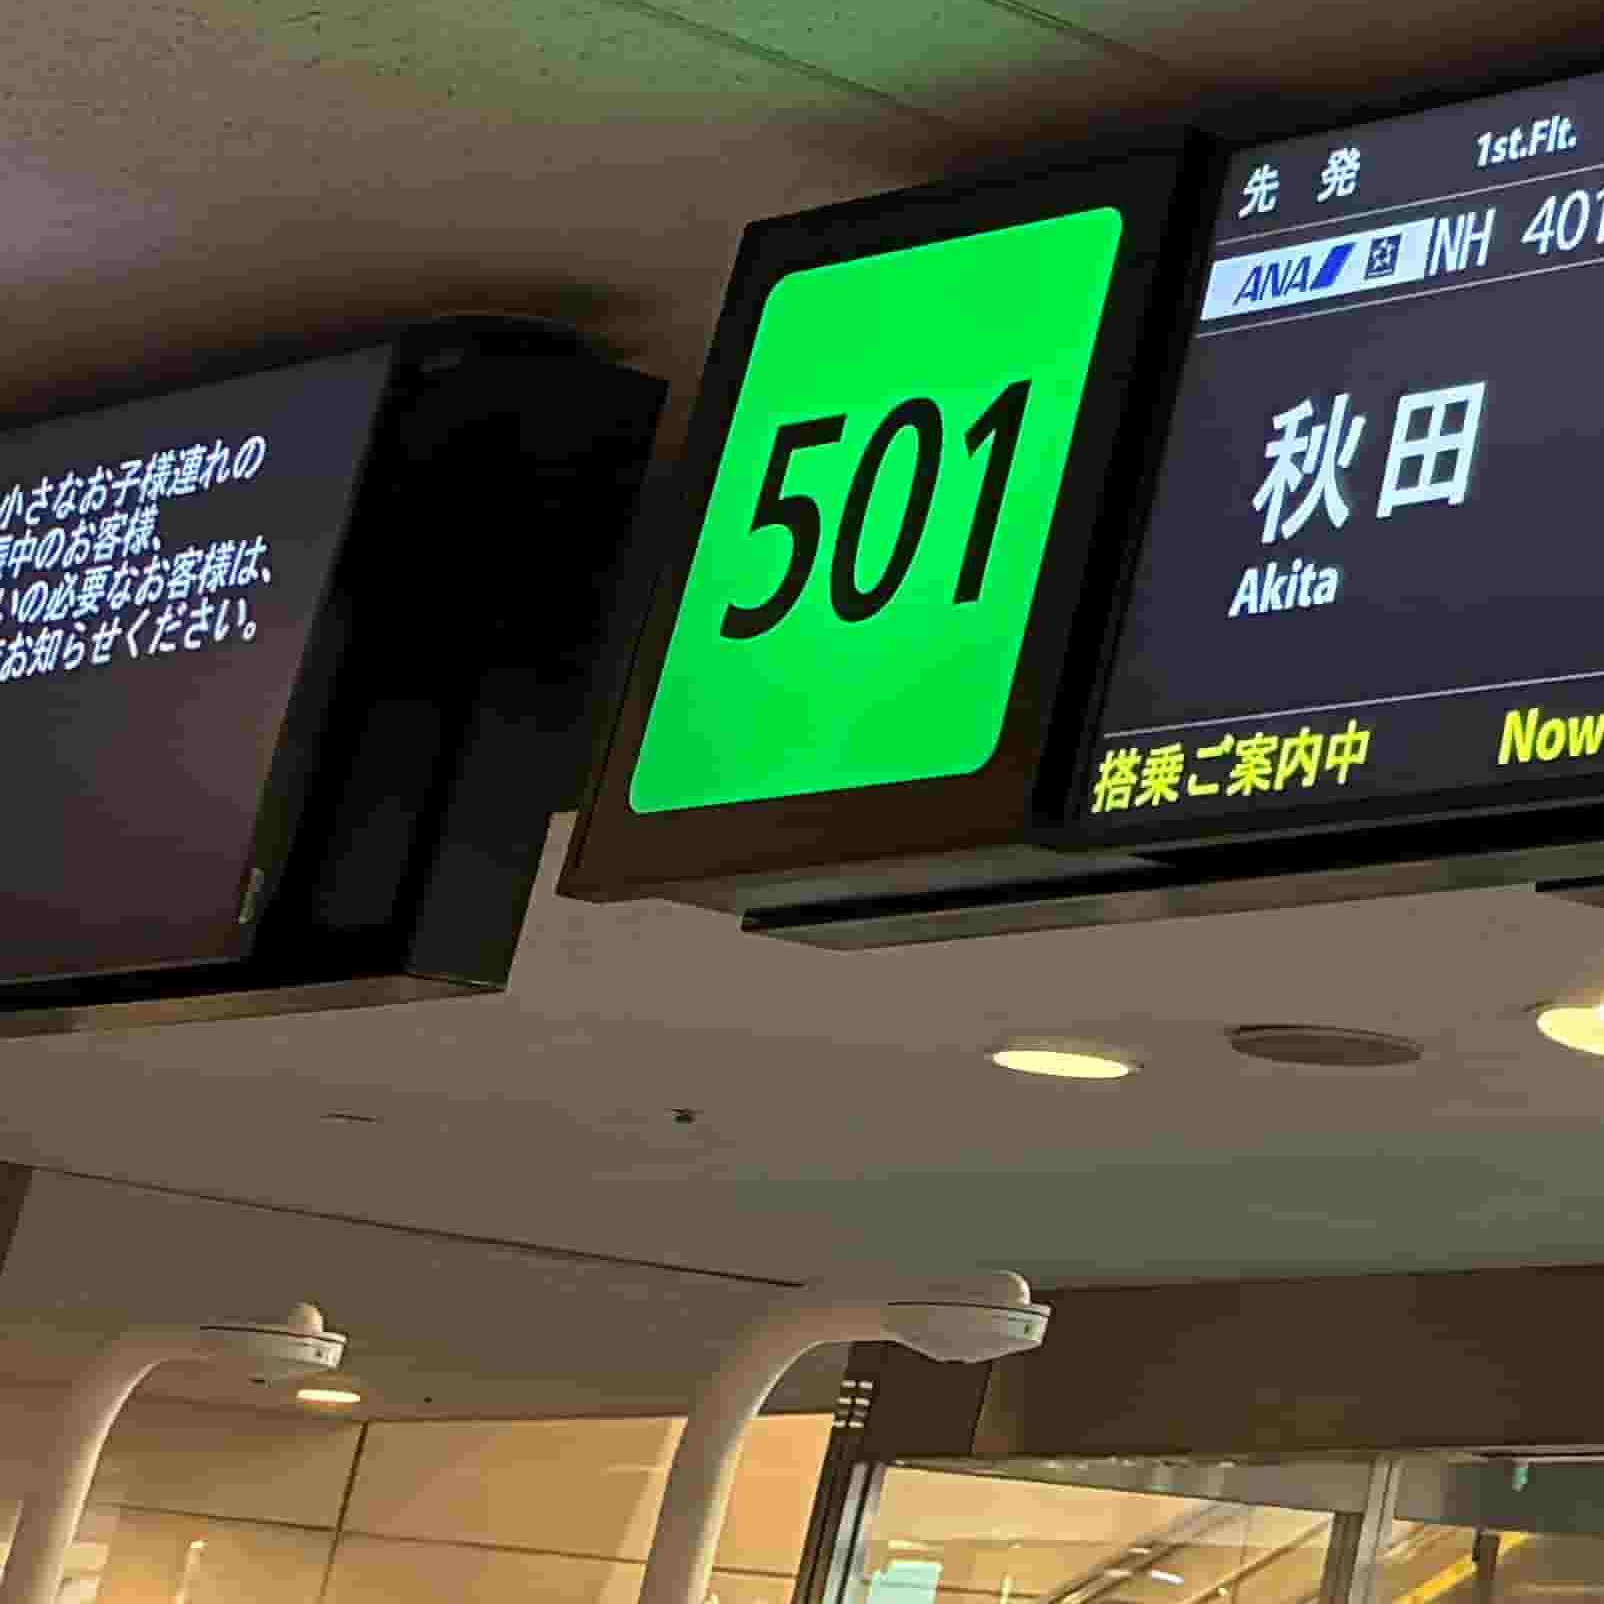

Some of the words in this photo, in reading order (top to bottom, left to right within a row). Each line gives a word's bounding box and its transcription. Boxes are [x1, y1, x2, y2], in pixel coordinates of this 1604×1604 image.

[1477, 114, 1578, 167] 1st.Flt.
[1233, 254, 1314, 307] ANA
[1429, 208, 1497, 277] NH
[719, 378, 1032, 641] 501
[1252, 381, 1487, 545] 秋田
[1228, 558, 1339, 619] Akita
[0, 597, 257, 683] お知らせください。
[1090, 719, 1371, 814] 搭乗ご案内中
